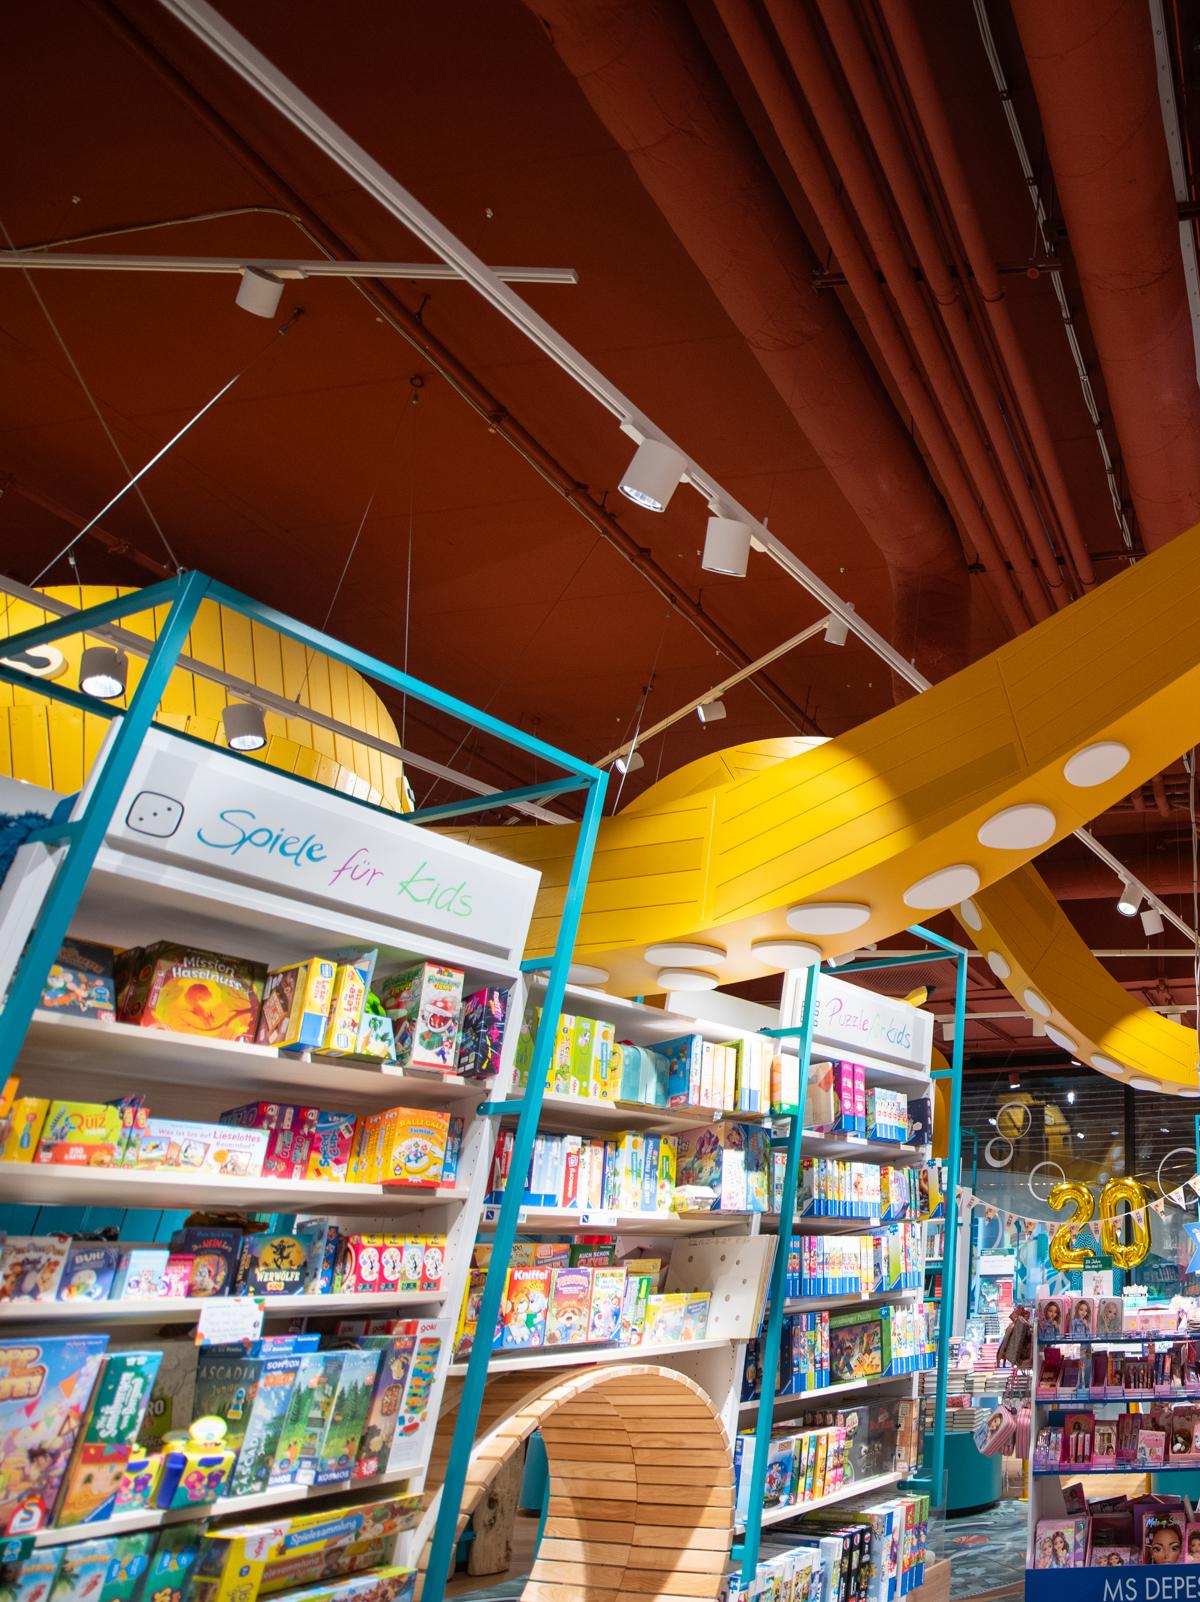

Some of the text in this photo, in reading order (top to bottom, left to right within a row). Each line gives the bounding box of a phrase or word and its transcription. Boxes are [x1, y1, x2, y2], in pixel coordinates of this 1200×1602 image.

[197, 808, 327, 867] Spiele
[328, 847, 385, 887] für
[183, 955, 236, 977] Mission
[171, 966, 243, 991] Haselnuss
[826, 997, 869, 1031] Puzzle
[514, 1270, 548, 1281] Kniffel
[1103, 1578, 1138, 1602] MS
